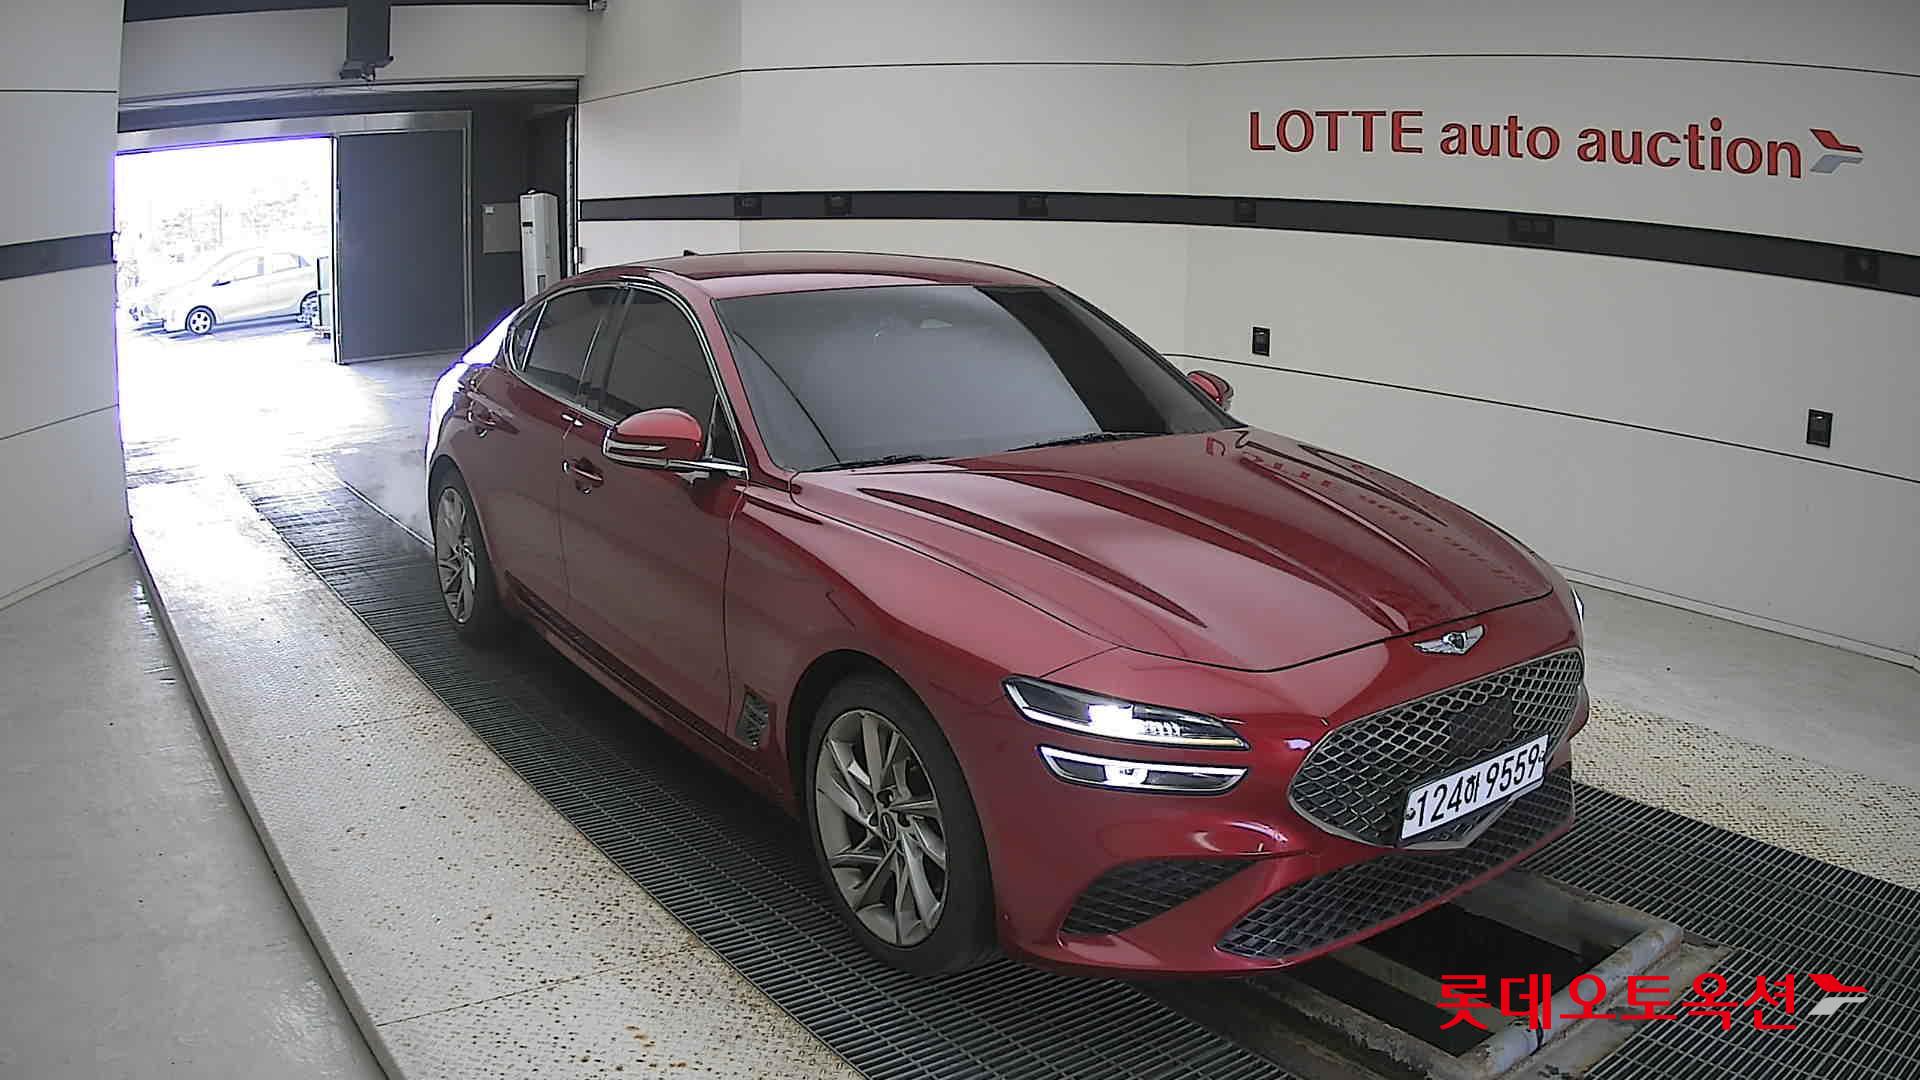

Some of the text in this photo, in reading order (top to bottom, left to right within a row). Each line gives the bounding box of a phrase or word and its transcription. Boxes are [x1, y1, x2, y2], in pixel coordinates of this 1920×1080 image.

[1249, 110, 1803, 179] LOTTE auto auction
[1486, 743, 1541, 799] 9559
